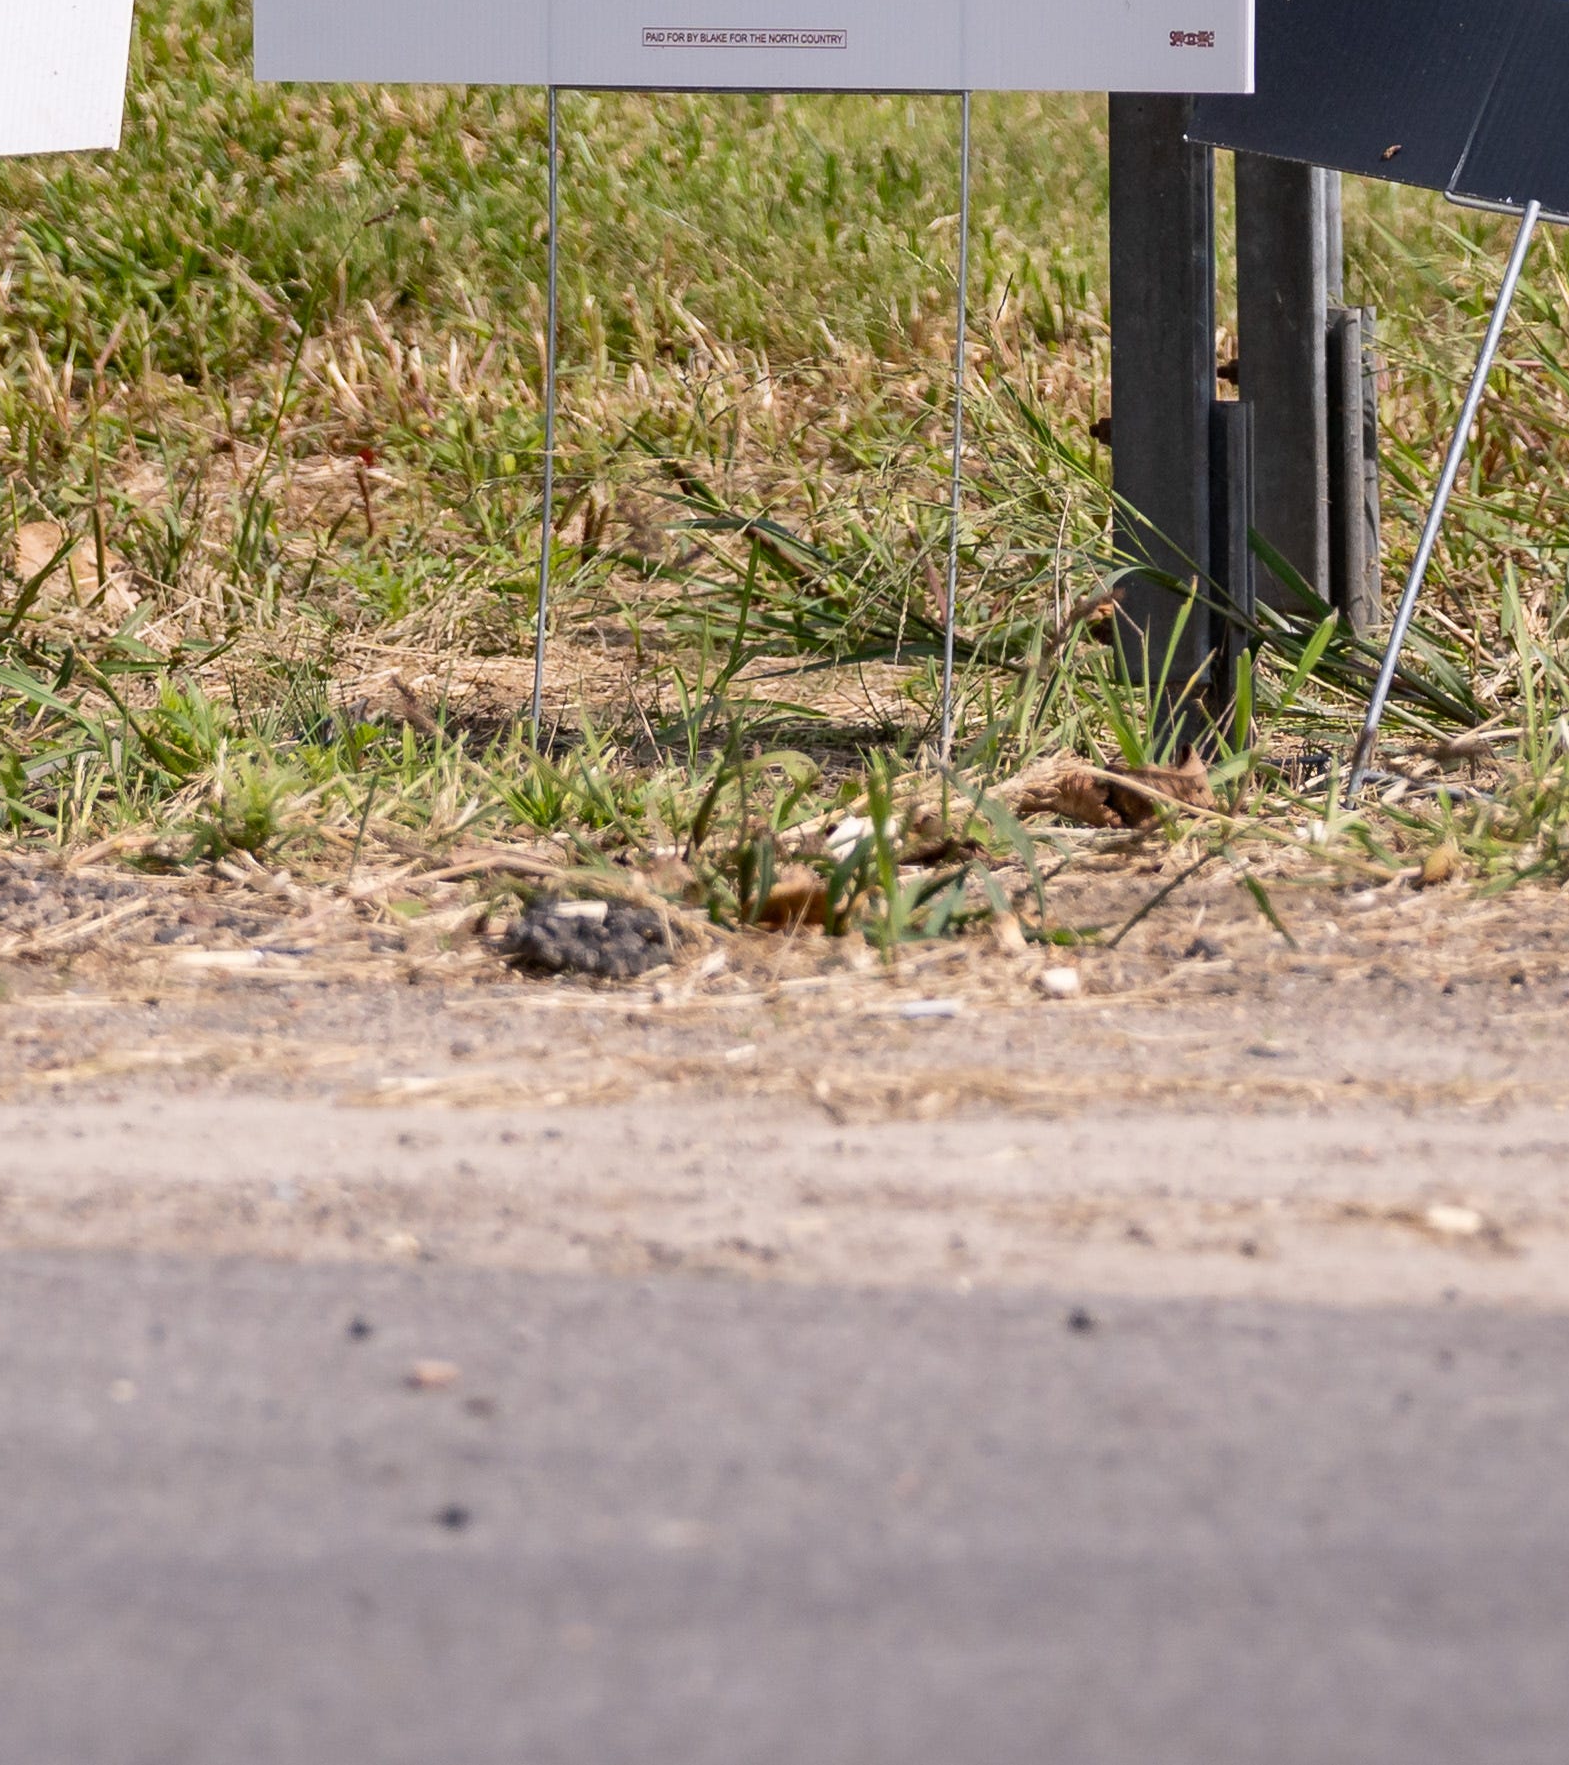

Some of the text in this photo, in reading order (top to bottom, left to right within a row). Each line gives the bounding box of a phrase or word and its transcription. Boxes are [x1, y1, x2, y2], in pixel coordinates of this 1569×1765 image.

[645, 32, 843, 44] PAID FOR BY BLAKE FOR THE NORTH COUNTRY
